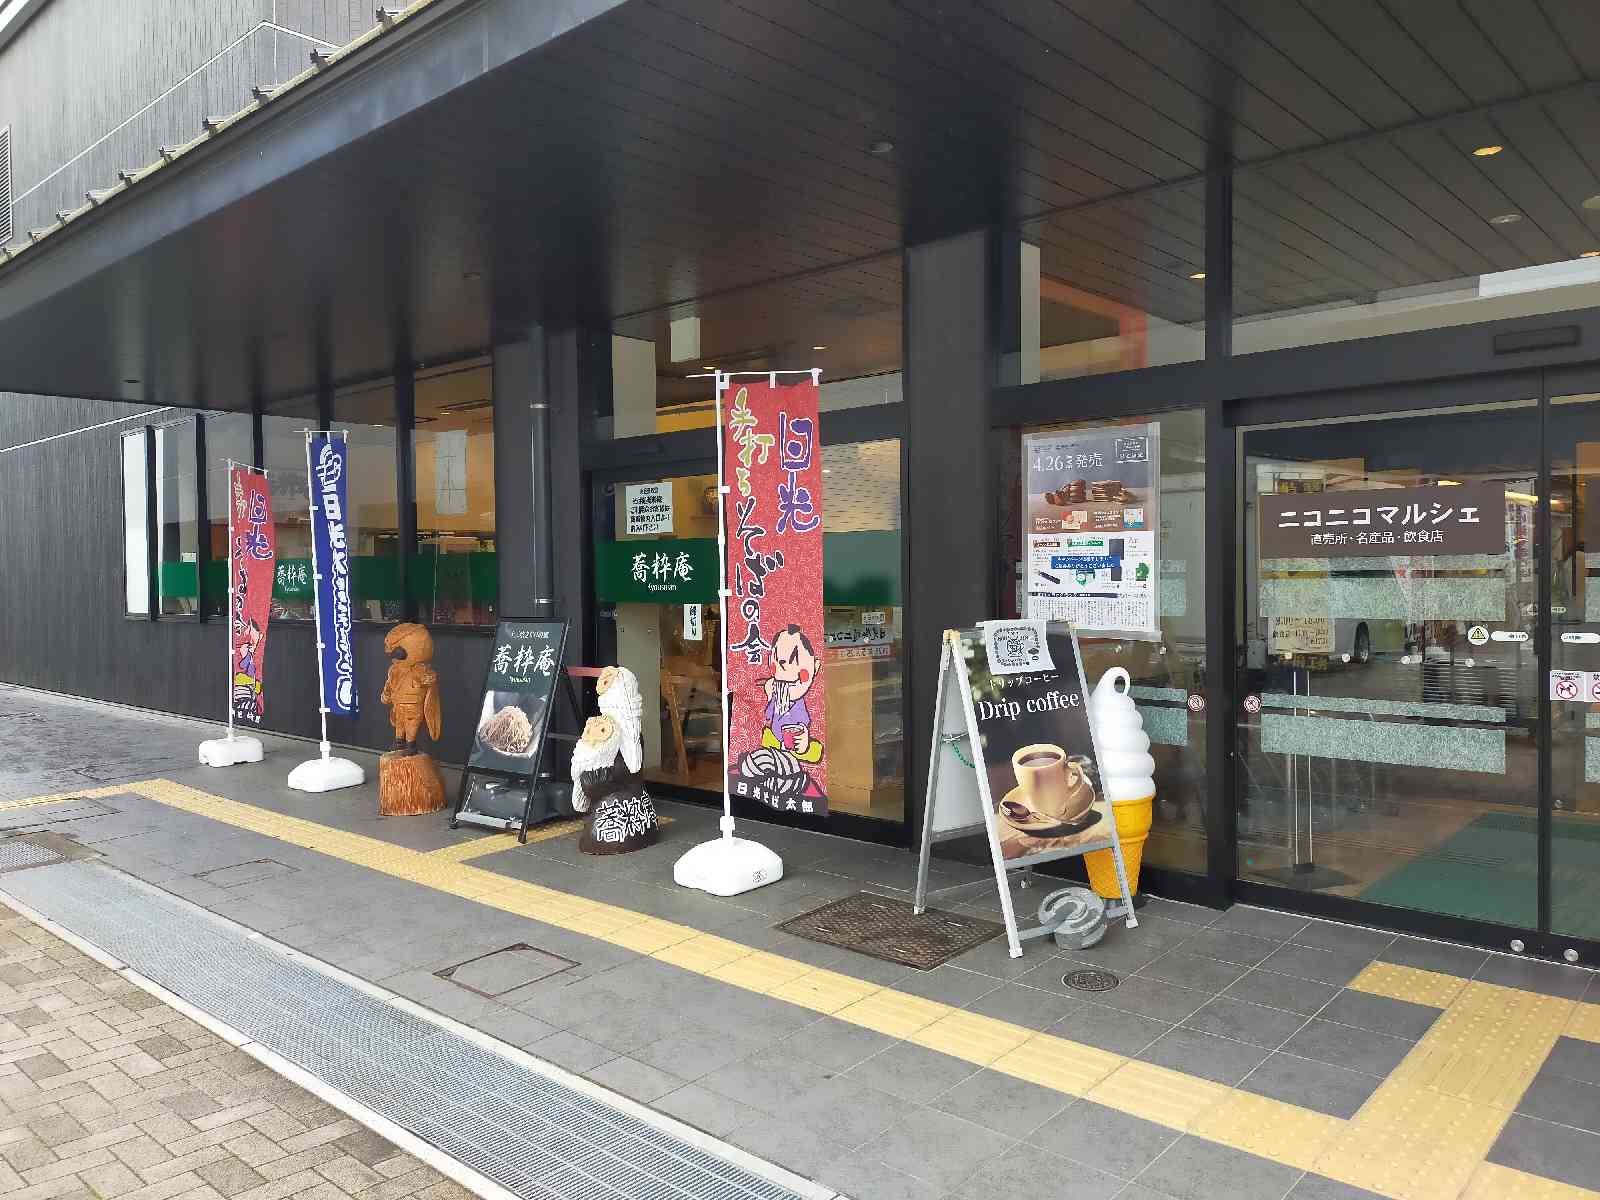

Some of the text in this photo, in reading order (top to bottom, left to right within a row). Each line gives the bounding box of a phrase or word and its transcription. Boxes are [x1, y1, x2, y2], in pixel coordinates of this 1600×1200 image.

[776, 411, 821, 533] 日光
[1278, 502, 1480, 528] ニコニコマルシェ
[631, 551, 694, 583] 蕎粋庵
[492, 643, 555, 676] 蕎粋庵
[978, 690, 1080, 720] Drip coffee
